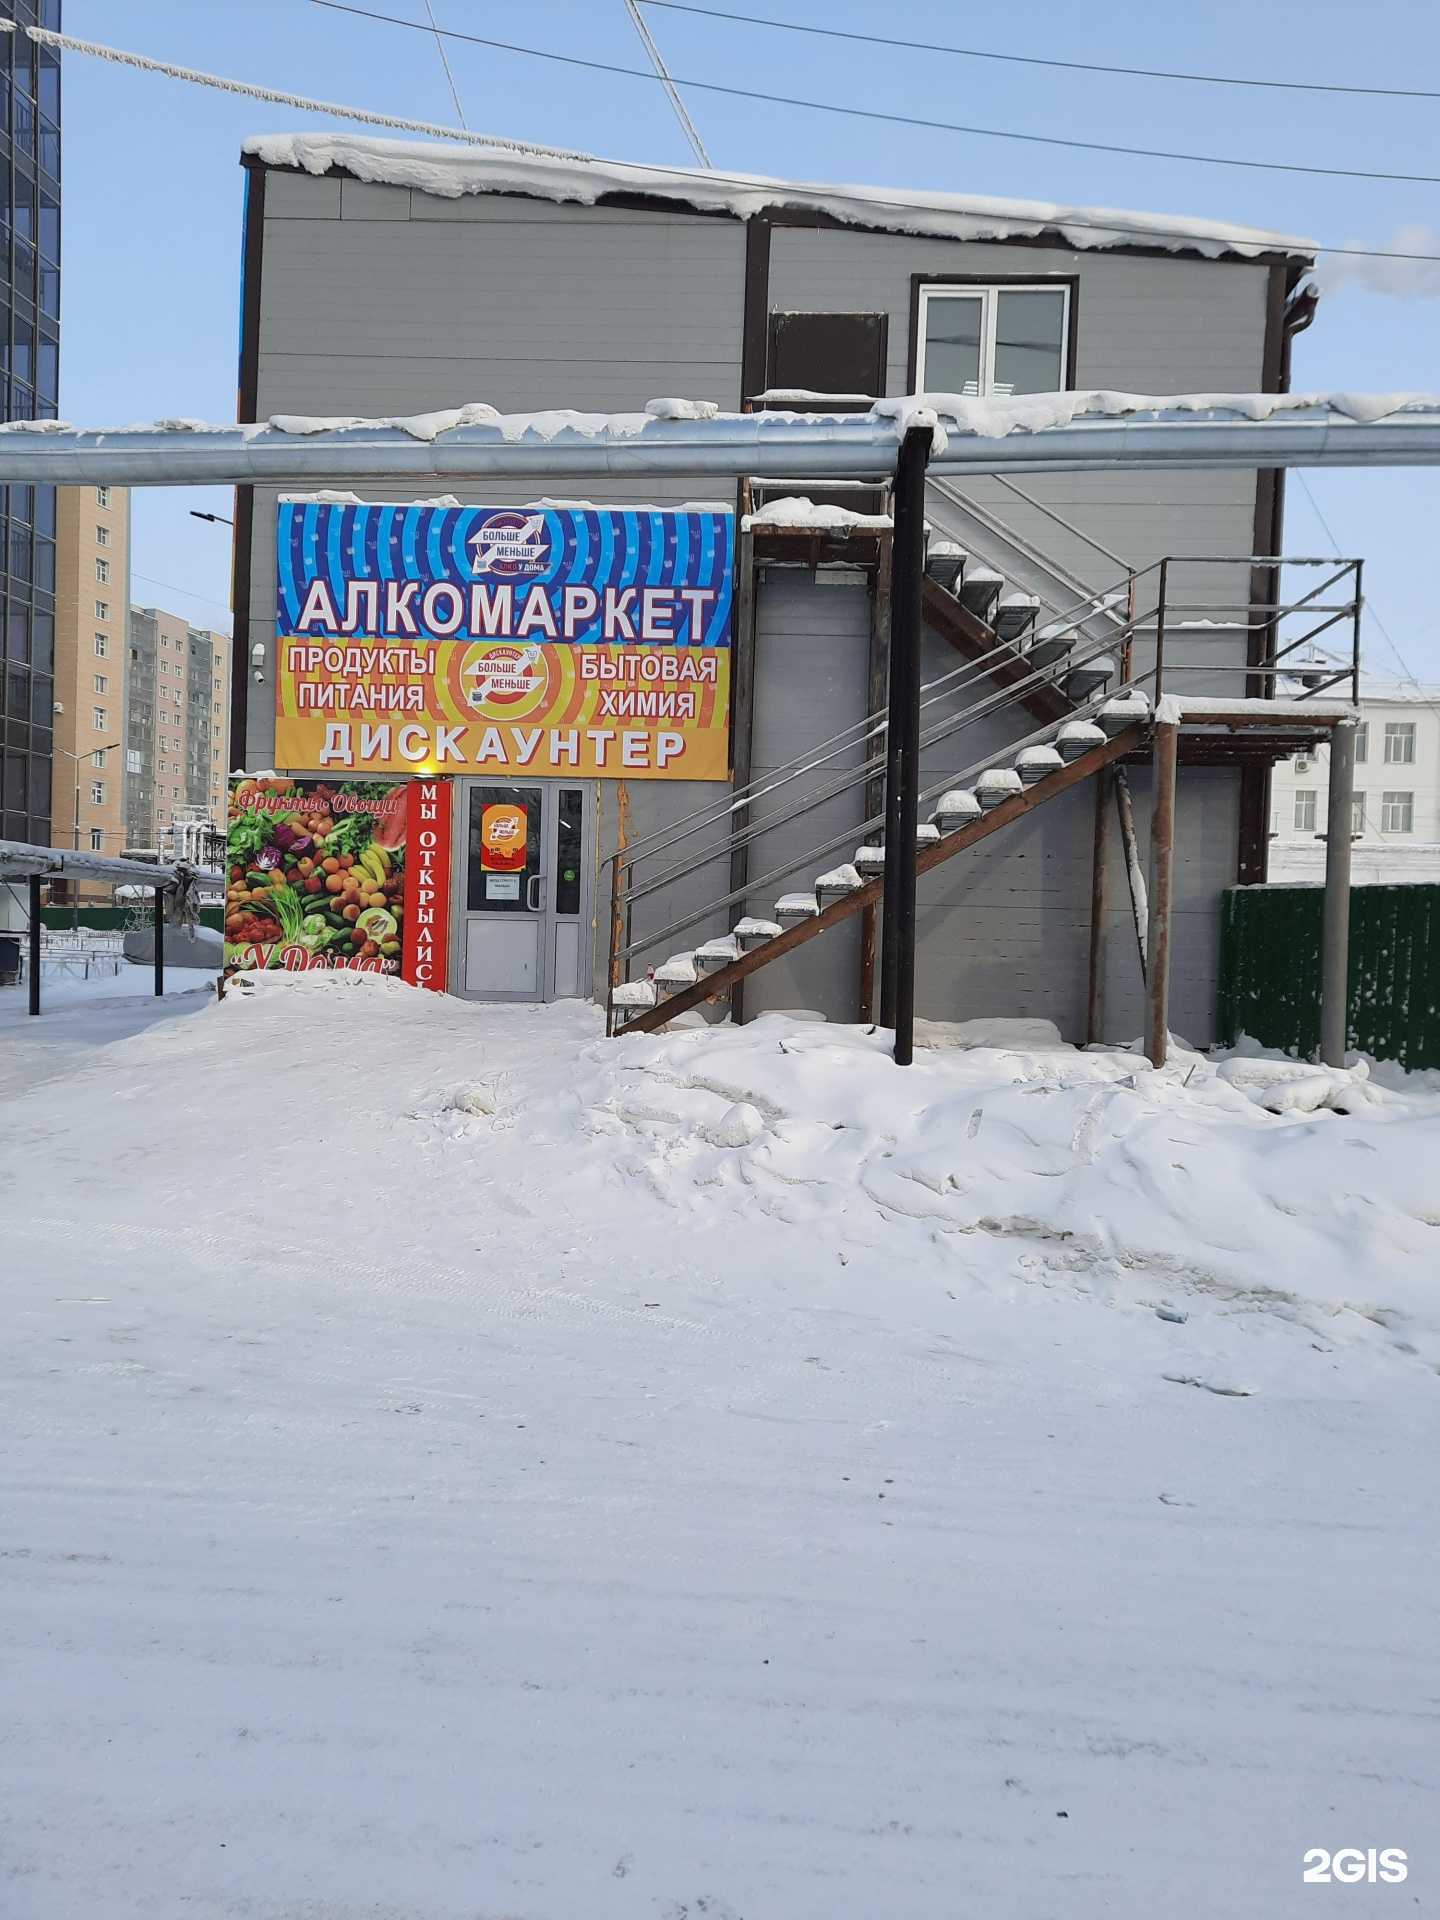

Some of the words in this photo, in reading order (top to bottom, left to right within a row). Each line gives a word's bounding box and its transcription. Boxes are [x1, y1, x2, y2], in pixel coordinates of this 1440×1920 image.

[482, 530, 520, 541] БОЛЬШЕ
[496, 546, 535, 557] МЕНЬШЕ
[298, 580, 716, 641] АЛКОМАРКЕТ
[288, 646, 436, 676] ПРОДУКТЫ
[478, 662, 517, 673] БОЛЬШЕ
[580, 653, 718, 682] БЫТОВАЯ
[298, 682, 425, 711] ПИТАНИЯ
[491, 678, 531, 689] МЕНЬШЕ
[599, 689, 696, 719] ХИМИЯ
[318, 722, 687, 769] ДИСКАУНТЕР
[420, 784, 437, 820] МЫ
